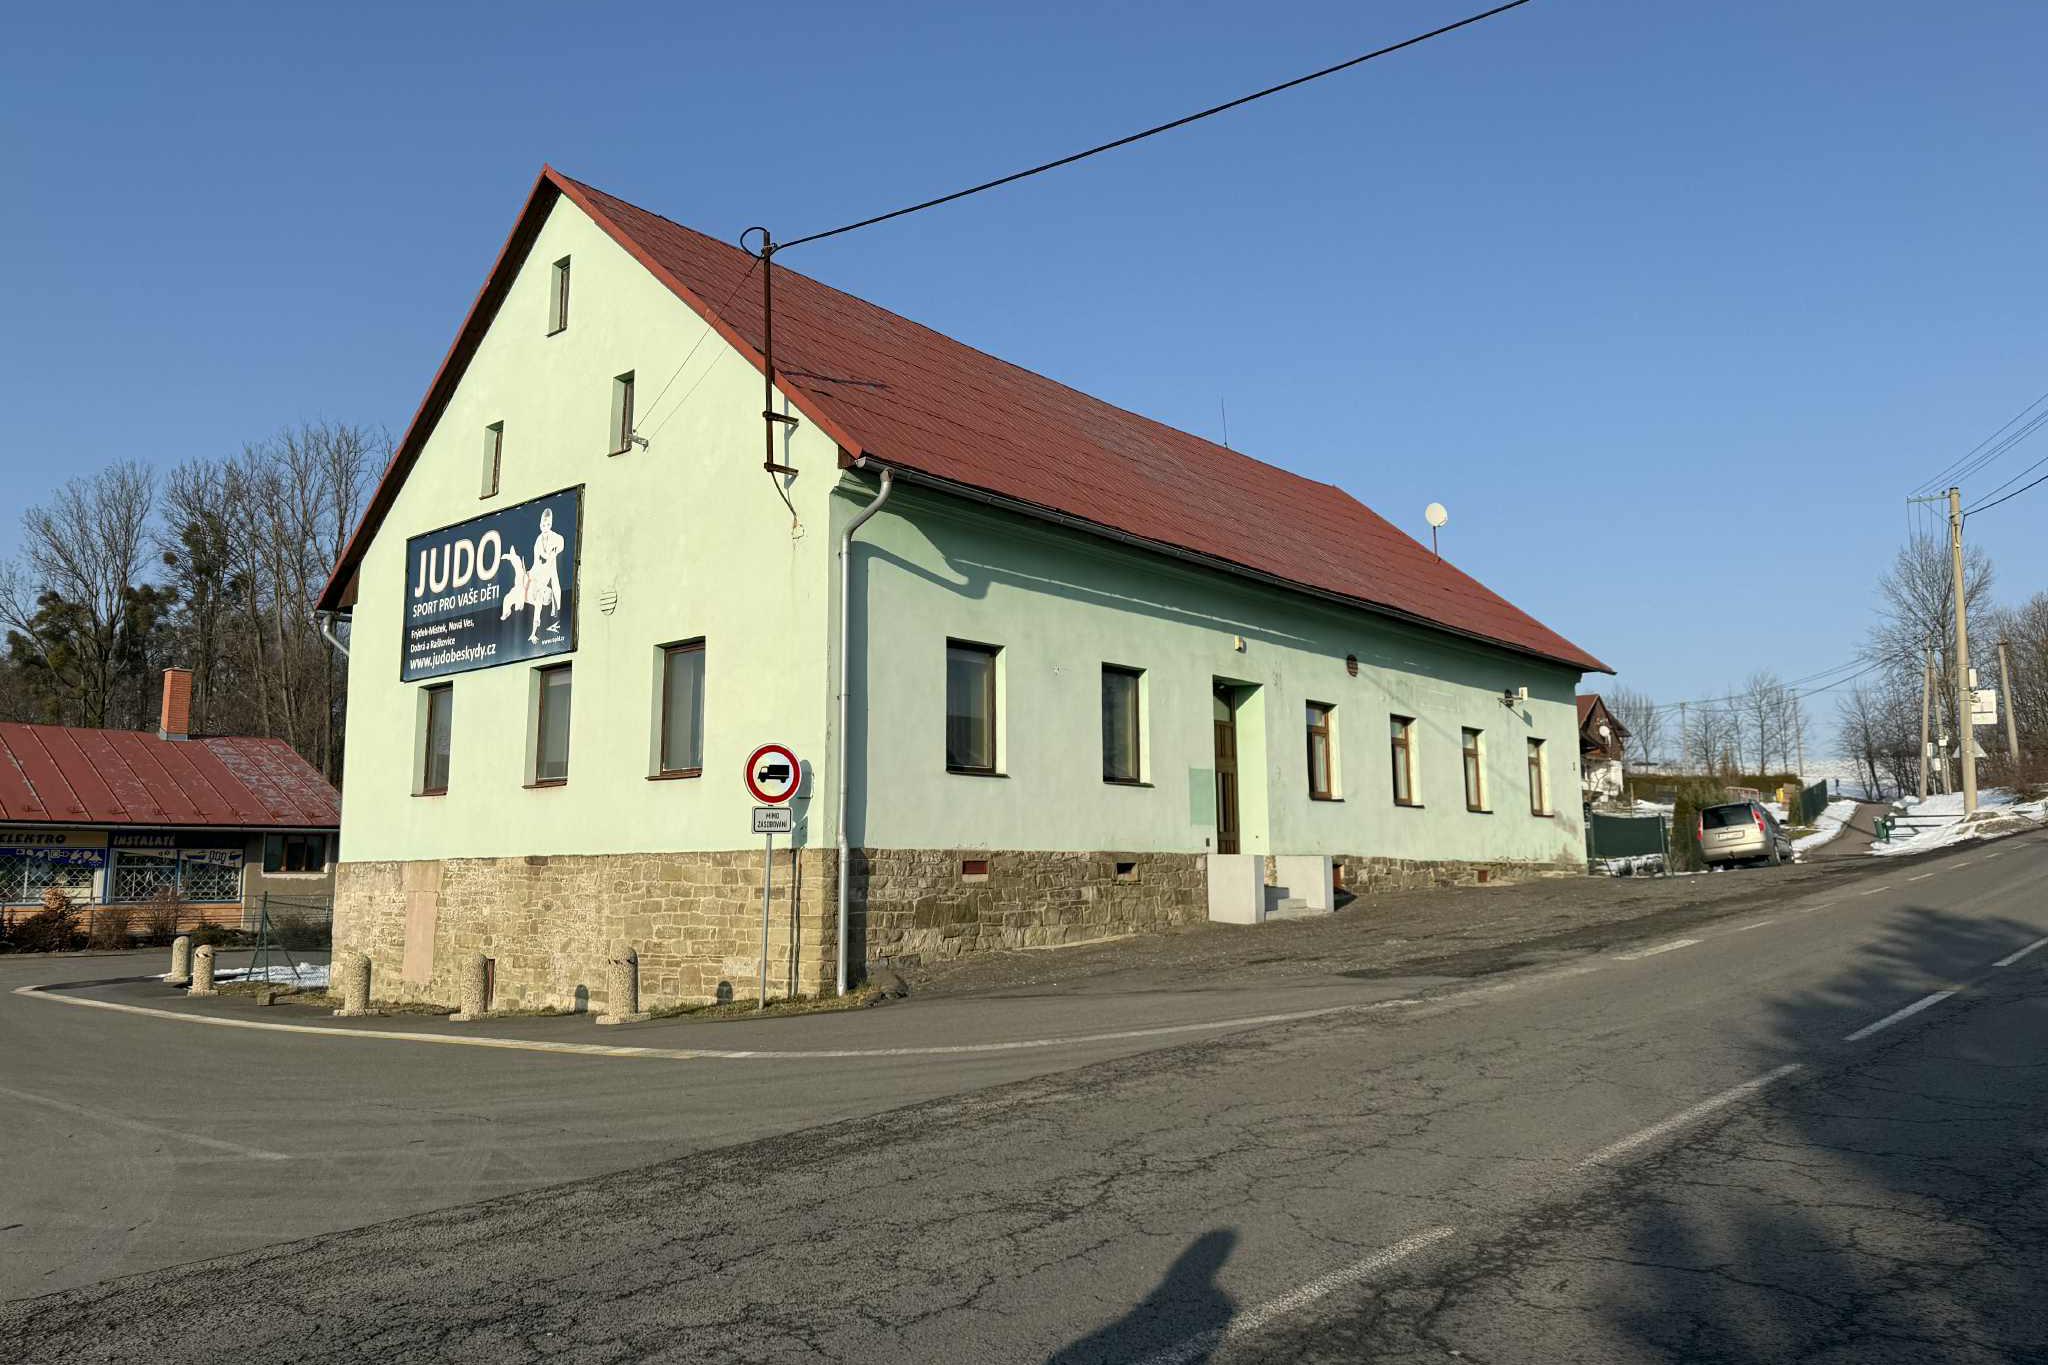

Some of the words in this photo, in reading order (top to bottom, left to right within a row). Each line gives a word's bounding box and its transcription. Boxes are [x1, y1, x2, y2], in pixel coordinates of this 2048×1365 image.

[414, 530, 502, 598] JUDO
[412, 602, 438, 617] SPORT
[439, 595, 456, 612] PRO
[457, 588, 479, 607] VAŠE
[480, 583, 500, 602] DĚTI
[448, 619, 463, 631] Nová
[410, 641, 426, 653] Dobrá
[410, 643, 497, 670] www.judobeskydy.cz
